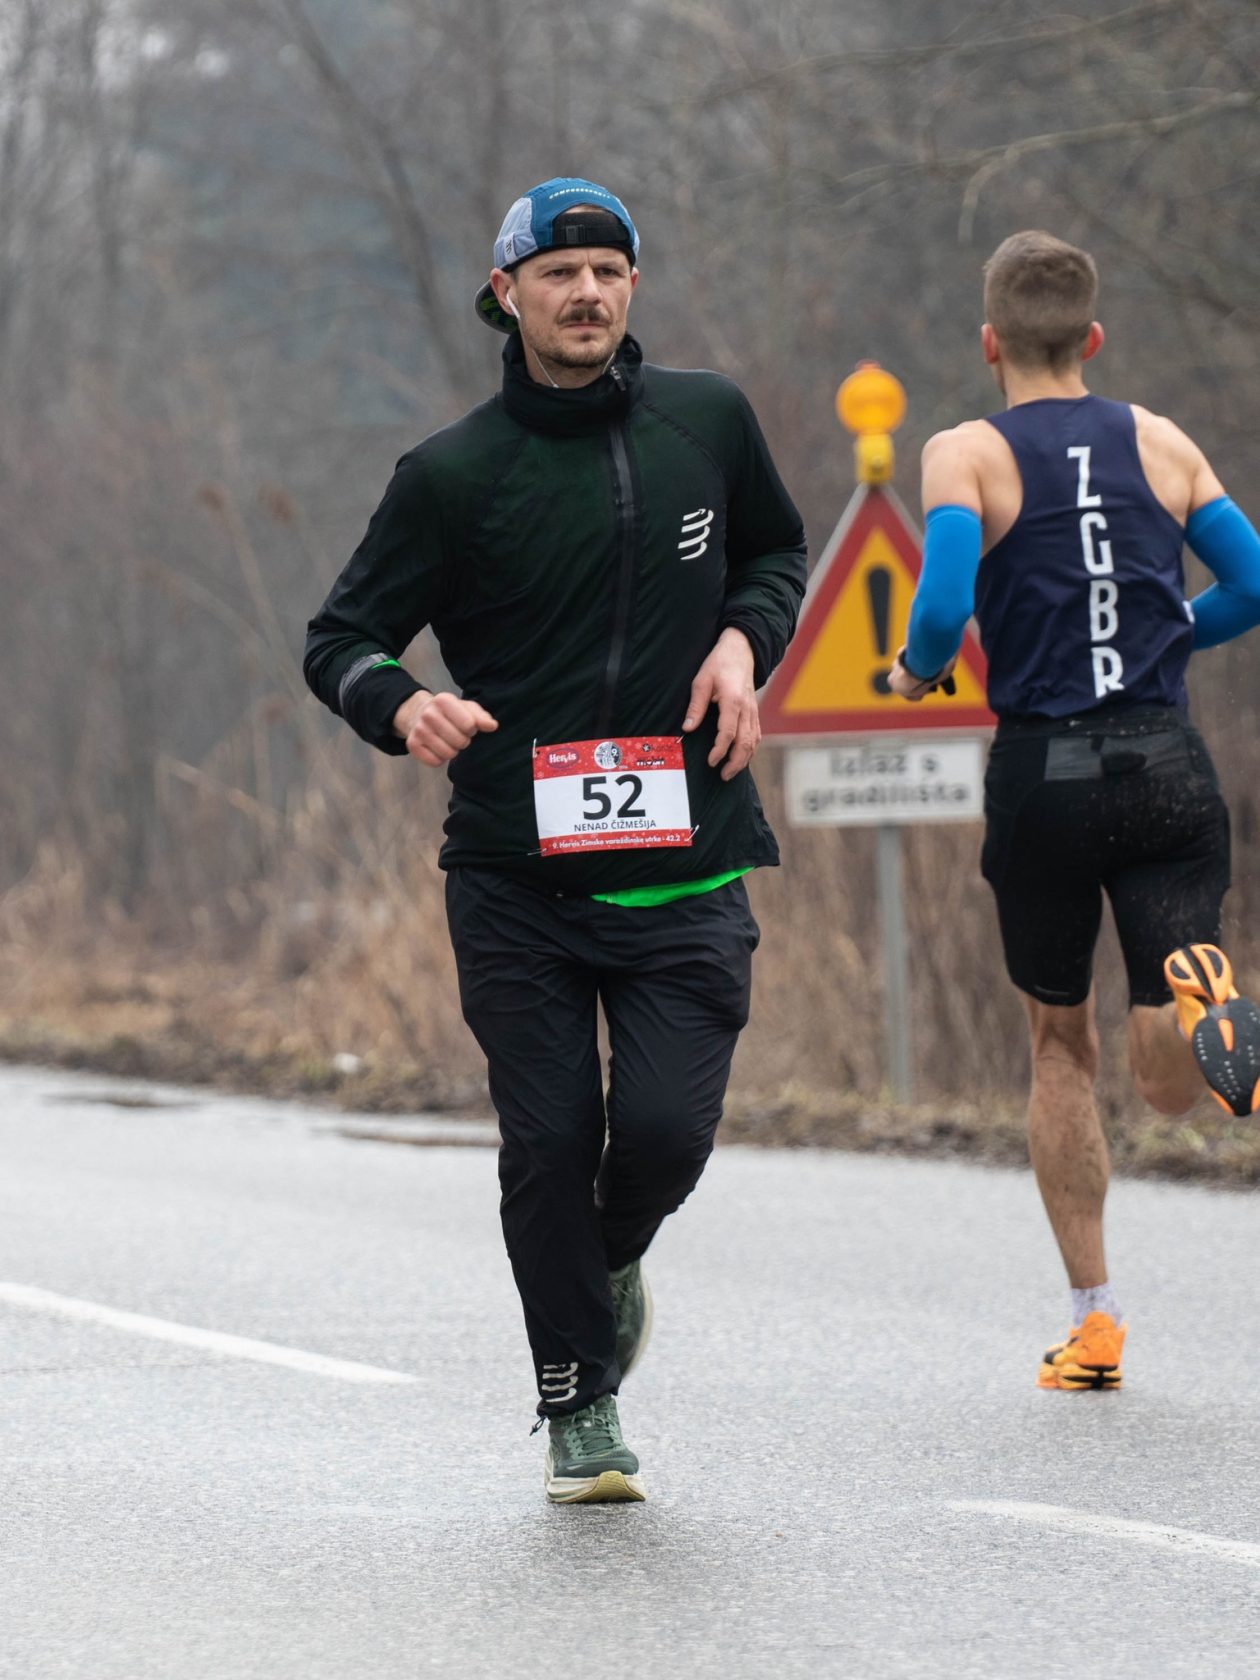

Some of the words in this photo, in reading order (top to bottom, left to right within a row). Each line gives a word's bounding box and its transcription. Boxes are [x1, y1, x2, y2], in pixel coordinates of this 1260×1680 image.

[1067, 446, 1125, 698] ZGBR
[549, 752, 577, 764] Hervis
[583, 774, 646, 820] 52
[574, 821, 608, 832] NENAD
[611, 819, 657, 831] ČIŽMEŠIJA
